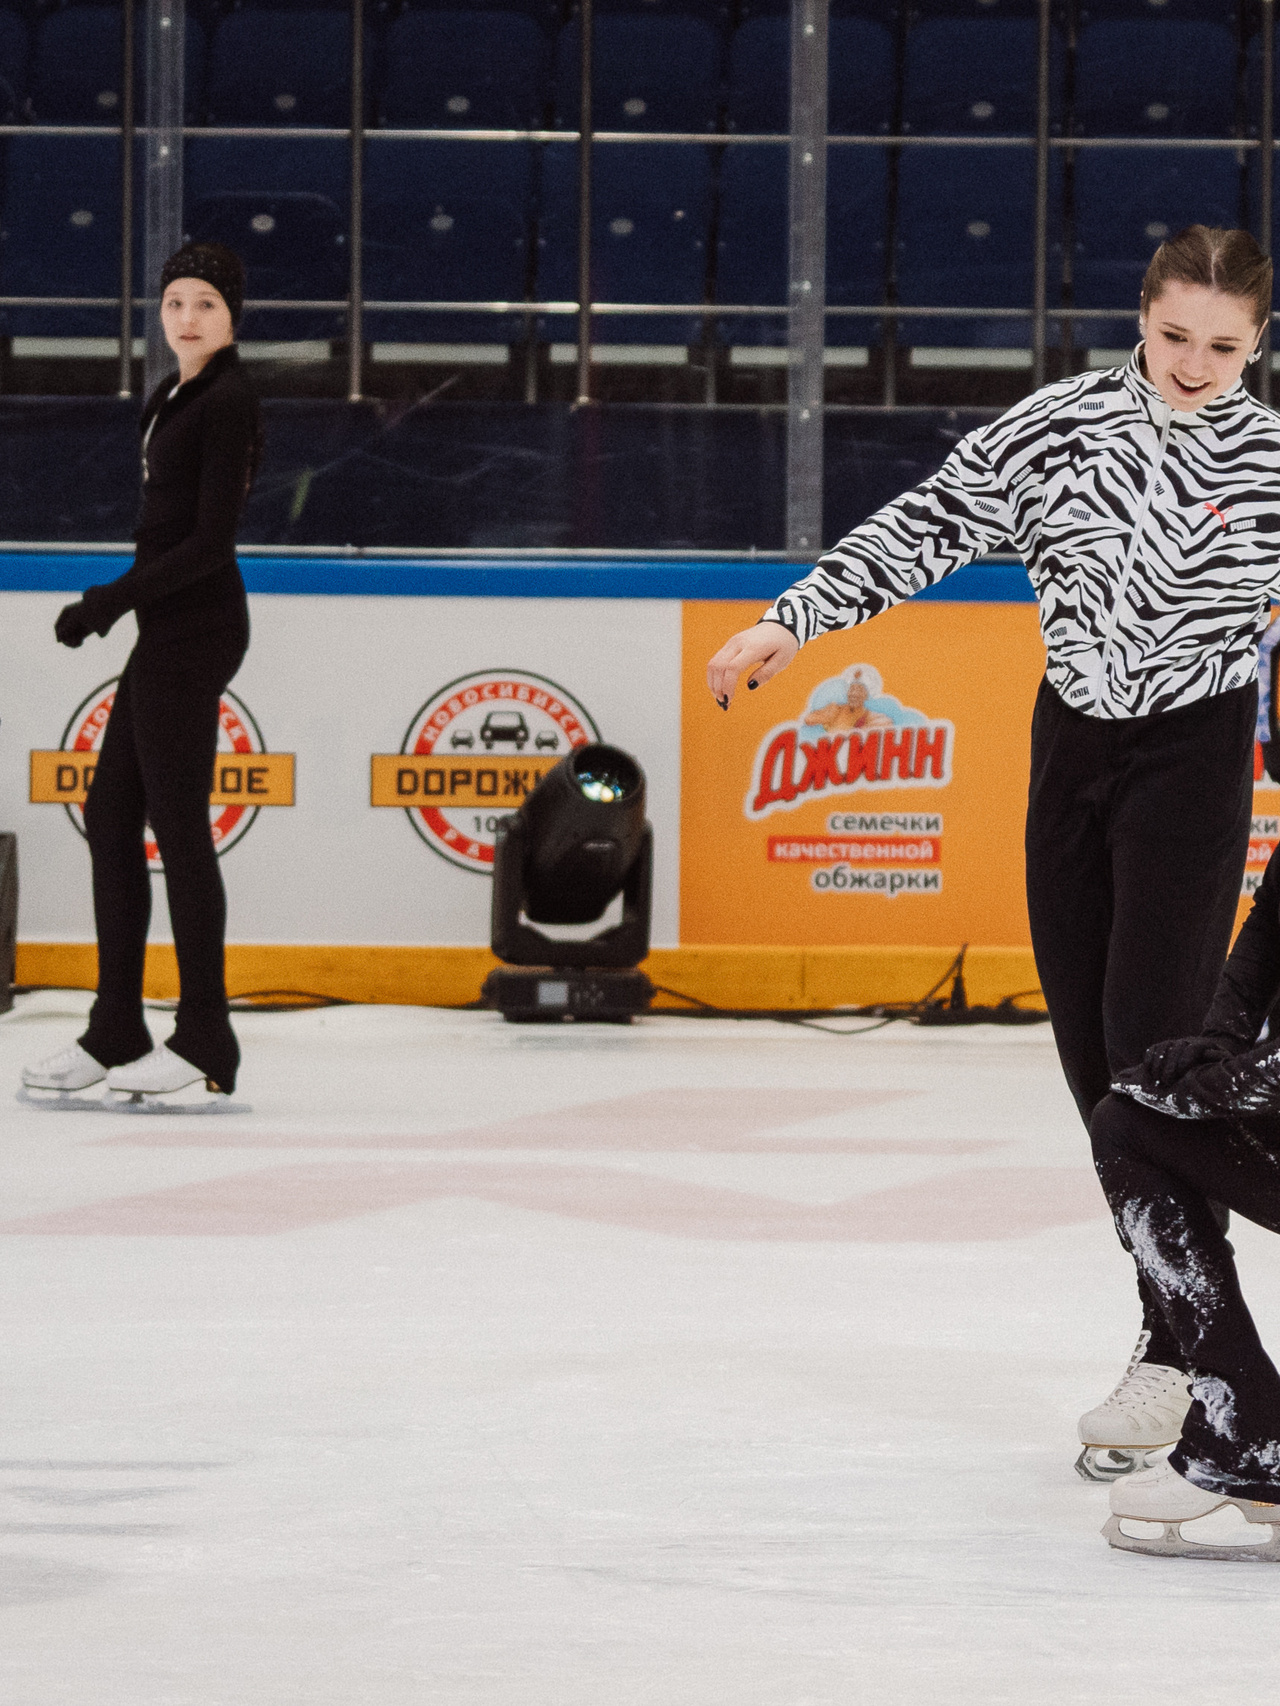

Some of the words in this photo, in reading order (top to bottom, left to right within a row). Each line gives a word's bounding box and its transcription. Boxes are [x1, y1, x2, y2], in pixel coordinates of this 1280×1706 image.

[1078, 401, 1105, 412] PUMA
[1010, 464, 1034, 486] PUMA
[1067, 506, 1091, 522] PUMA
[1230, 519, 1257, 532] PUMA
[424, 680, 590, 742] НОВОСИБИРСК
[829, 813, 941, 832] семечки
[773, 840, 935, 861] качественной
[813, 865, 941, 893] обжарки
